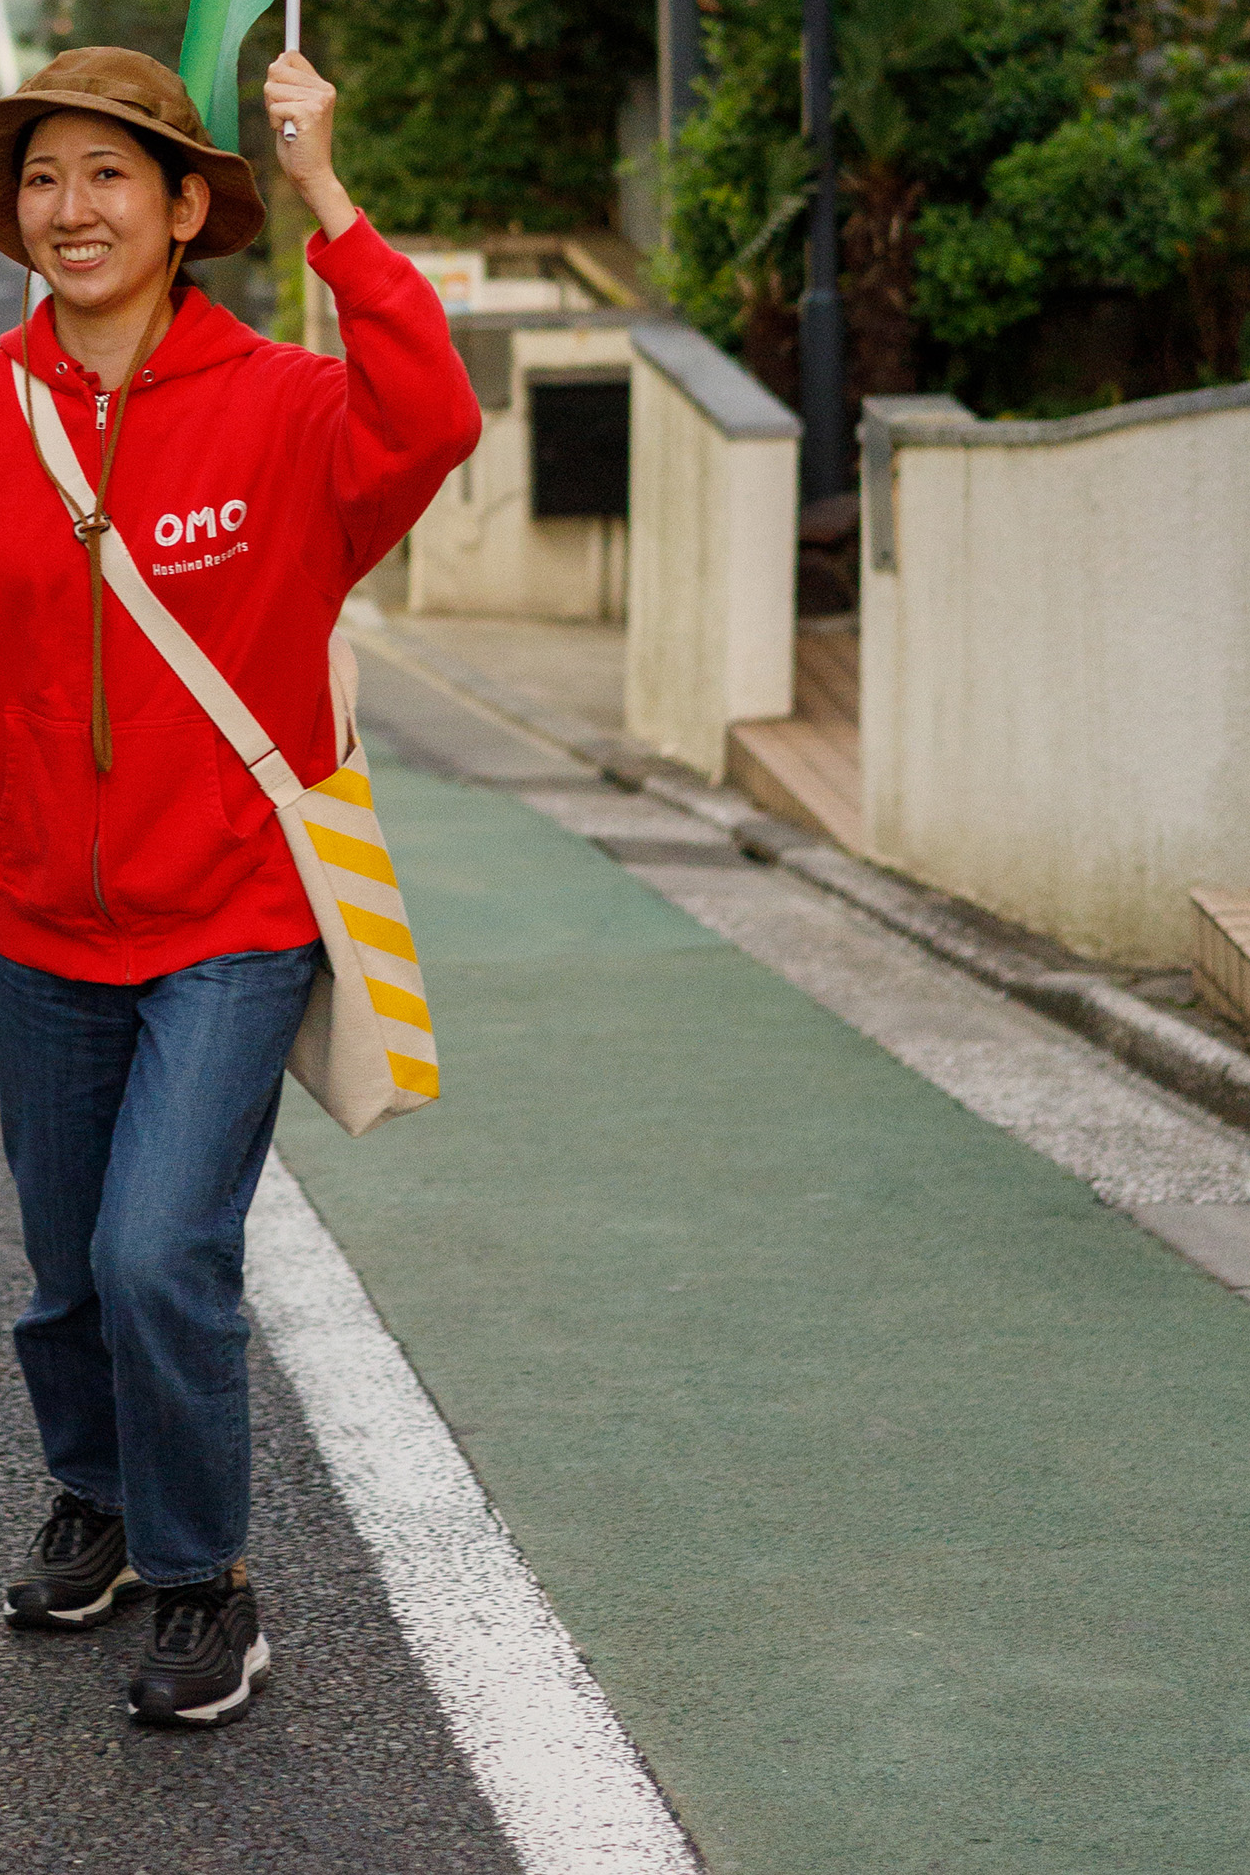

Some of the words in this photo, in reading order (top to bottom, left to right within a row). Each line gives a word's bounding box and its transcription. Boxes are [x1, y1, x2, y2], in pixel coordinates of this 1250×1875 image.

[154, 499, 248, 547] OMO
[152, 559, 203, 576] Hoshino
[204, 541, 249, 568] Resorts
